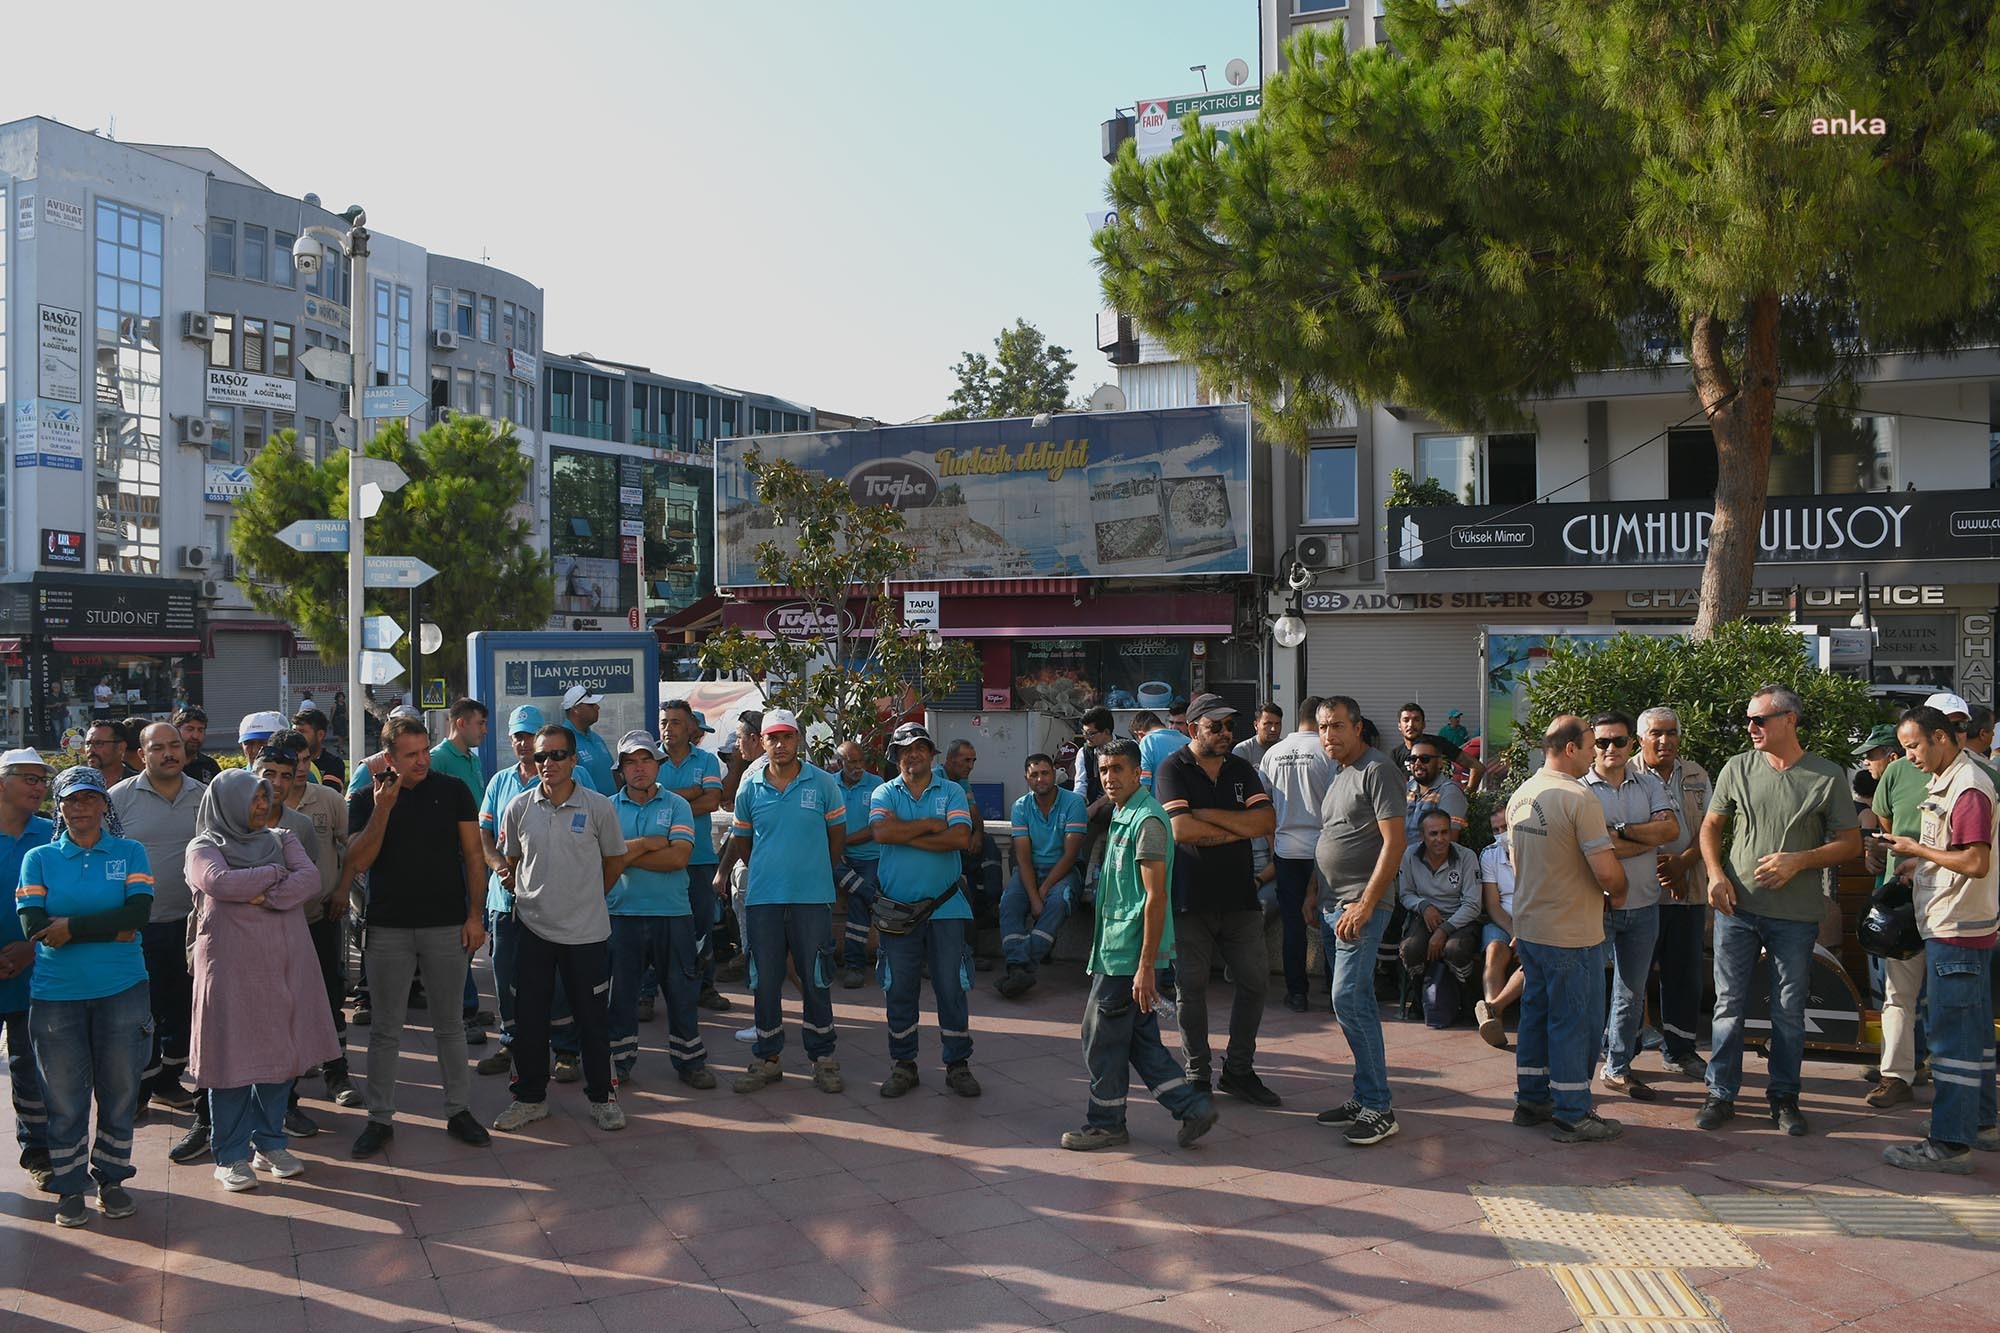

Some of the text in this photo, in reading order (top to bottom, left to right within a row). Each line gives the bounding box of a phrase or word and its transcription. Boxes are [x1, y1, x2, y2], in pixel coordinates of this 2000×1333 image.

[1175, 95, 1242, 113] ELEKTRİĞİ
[1142, 114, 1164, 128] FAIRY
[47, 199, 82, 216] AVUKAT
[42, 309, 78, 328] BAŞÖZ
[210, 372, 249, 389] BAŞÖZ
[212, 387, 247, 398] MİMARLIK
[364, 389, 395, 399] SAMOS
[934, 438, 1090, 482] Turkish delight
[209, 485, 253, 494] YUVAMI
[863, 473, 927, 507] Tuğba
[314, 523, 348, 533] SINAIA
[1562, 505, 1912, 555] CUMHUR ULUSOY
[1458, 530, 1526, 544] Yüksek Mimar
[366, 559, 418, 569] MONTEREY
[1306, 594, 1341, 608] 925
[1352, 593, 1442, 610] ADOIS
[1547, 592, 1585, 607] 925
[1626, 585, 1945, 608] CHAE OFFICE
[909, 600, 934, 608] TAPU
[1899, 627, 1938, 638] ALTIN
[534, 664, 630, 678] İLAN VE DUYURU
[559, 679, 607, 690] PANOSU
